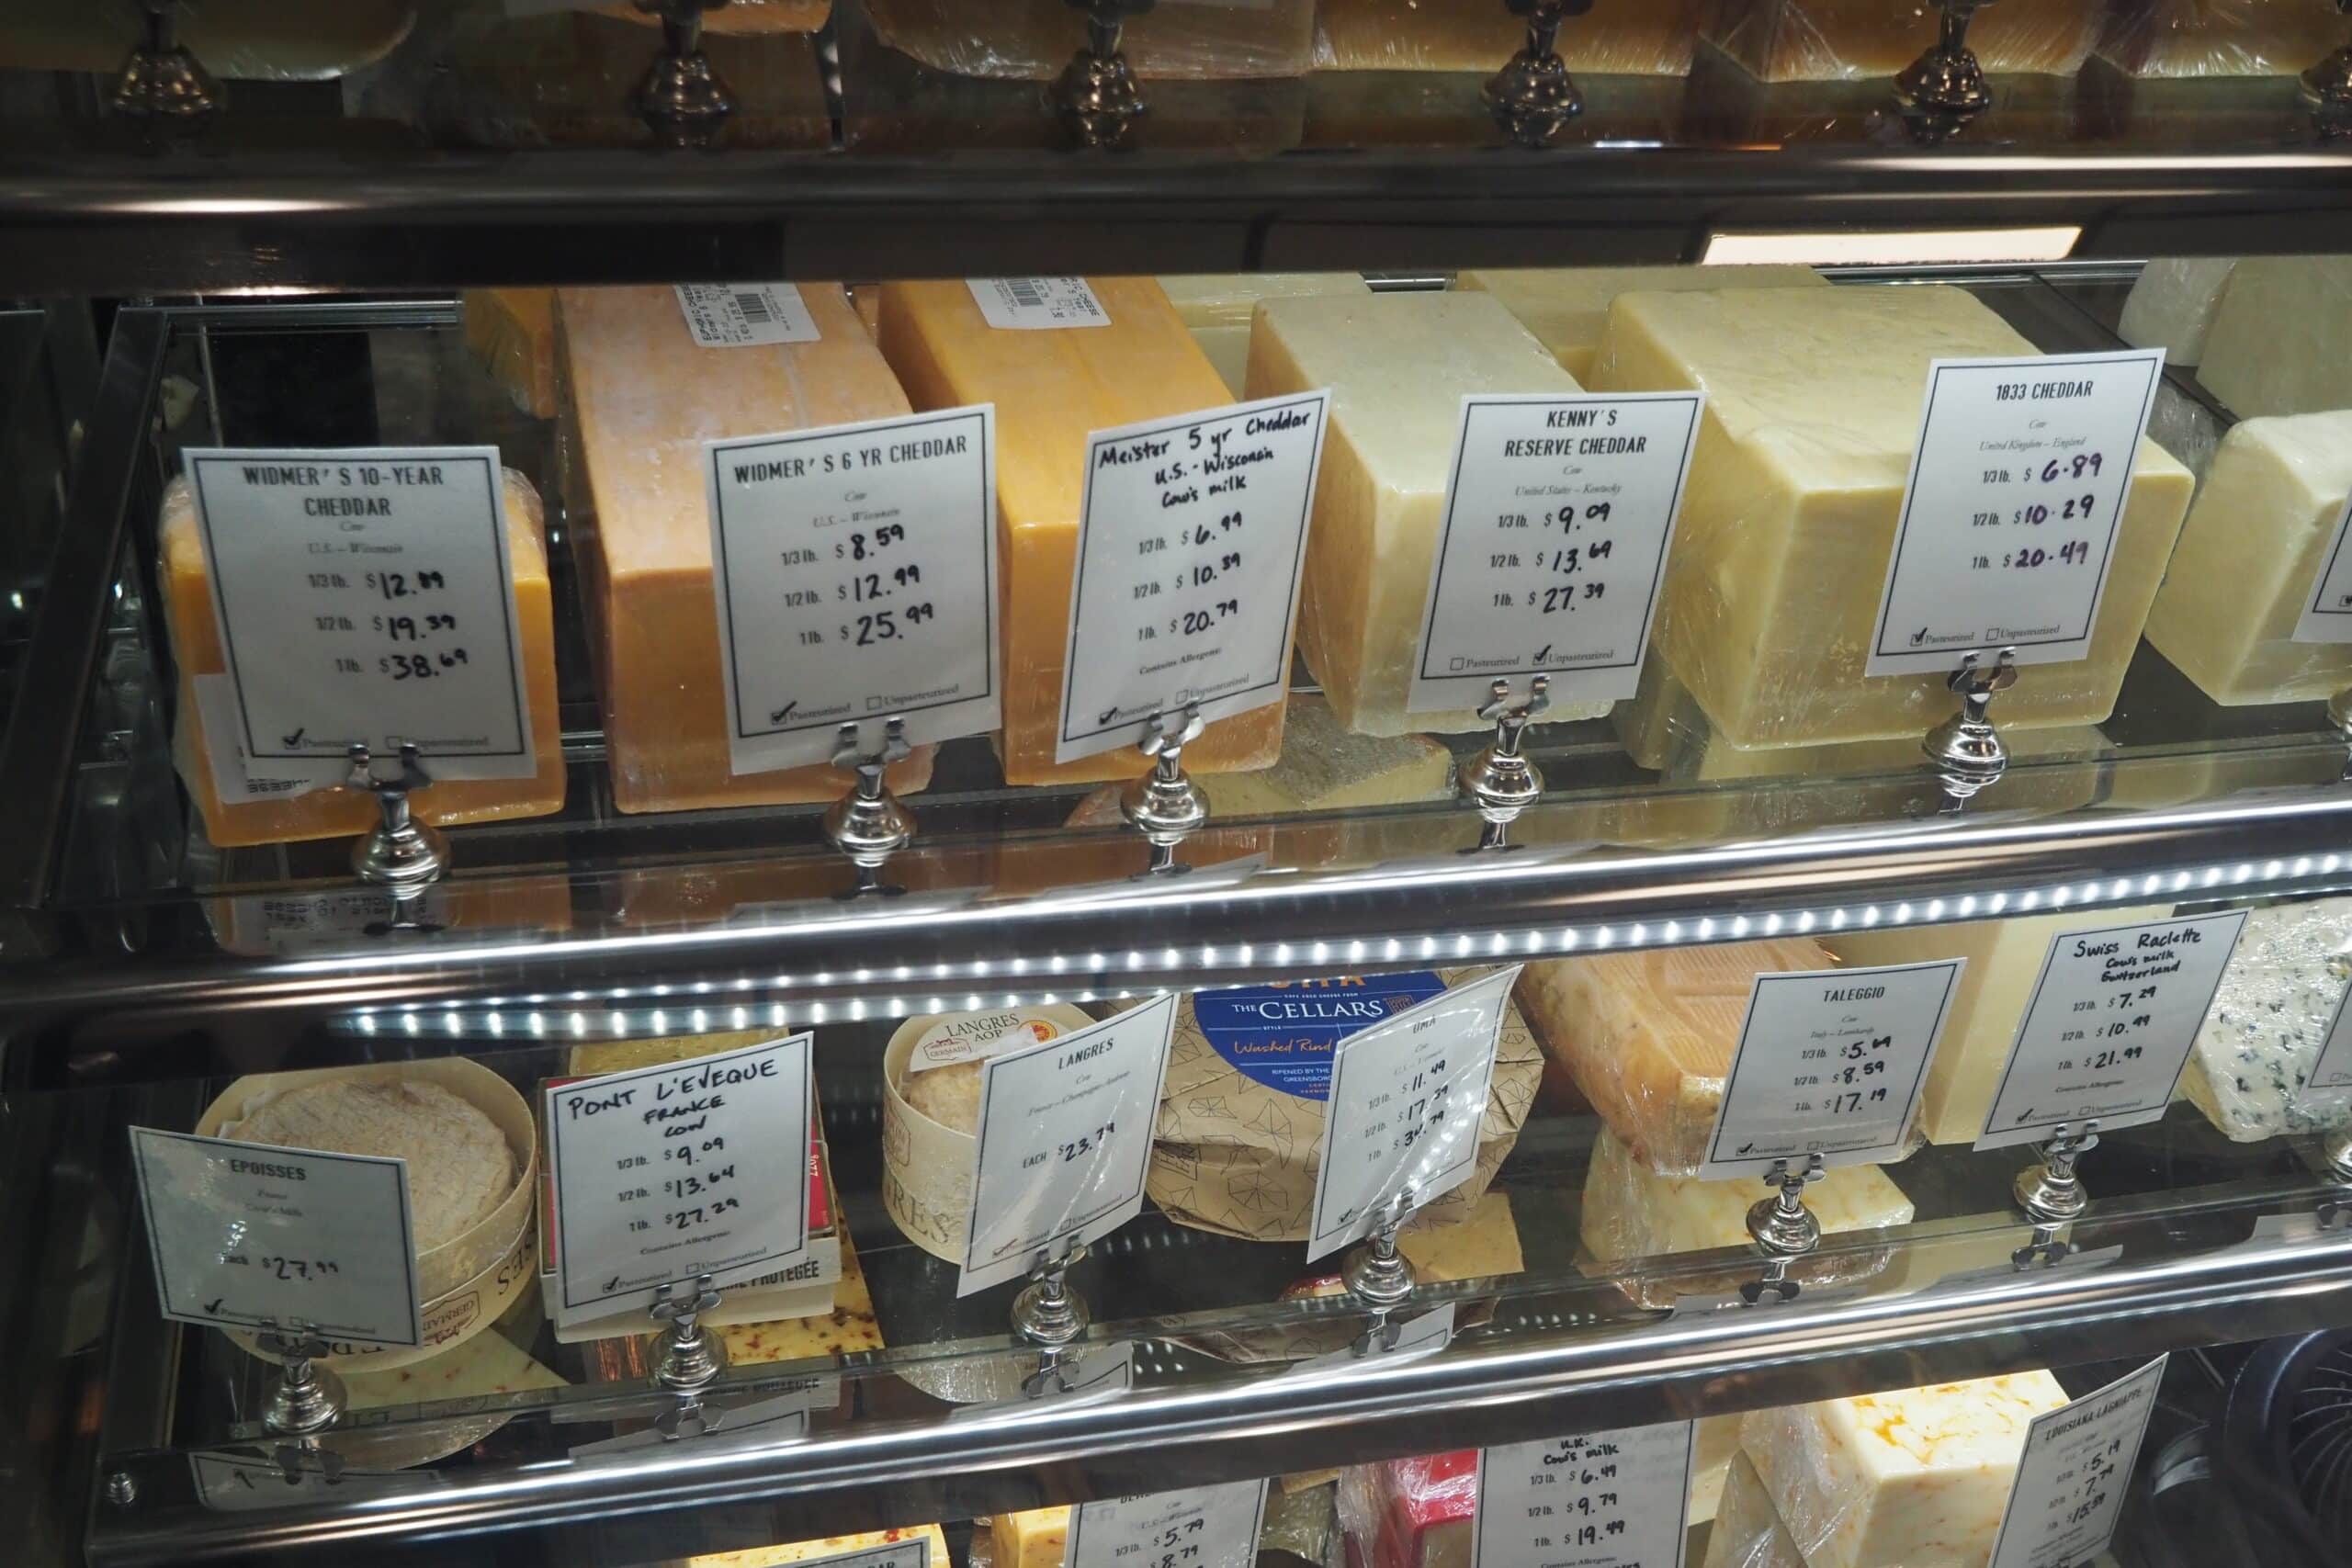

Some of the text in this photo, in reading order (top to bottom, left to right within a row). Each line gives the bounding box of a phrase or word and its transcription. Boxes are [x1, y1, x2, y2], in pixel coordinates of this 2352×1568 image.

[1996, 381, 2094, 401] 1833 CHEDDAR
[1100, 410, 1312, 468] Meister 5 yr Cheddar
[1504, 436, 1647, 457] RESERVE CHEDDAR
[842, 452, 853, 470] 6
[861, 447, 882, 468] YR
[890, 435, 967, 463] CHEDDAR
[358, 467, 444, 486] 10-YEAR
[1161, 475, 1247, 507] Cow's milk
[304, 498, 390, 516] CHEDDAR
[1498, 514, 1514, 527] 1/3
[781, 551, 800, 566] 1/3
[1490, 555, 1507, 568] 1/2
[785, 592, 804, 607] 1/2
[2074, 929, 2202, 959] Swiss Raclette
[1823, 987, 1885, 1001] TALEGGIO
[1231, 1004, 1257, 1012] THE
[1260, 1000, 1384, 1019] CELLARS
[946, 1013, 1020, 1037] LANGRES
[1413, 1018, 1435, 1033] UMA
[975, 1030, 1001, 1042] AOP
[1057, 1038, 1114, 1069] LANGRES
[1234, 1038, 1332, 1054] Washed Rind
[569, 1089, 637, 1120] PONT
[1023, 1151, 1047, 1168] EACH
[230, 1158, 307, 1181] EPOISSES
[1544, 1444, 1619, 1466] Cow's milk
[1531, 1475, 1544, 1484] 1/3
[1529, 1506, 1541, 1517] 1/2
